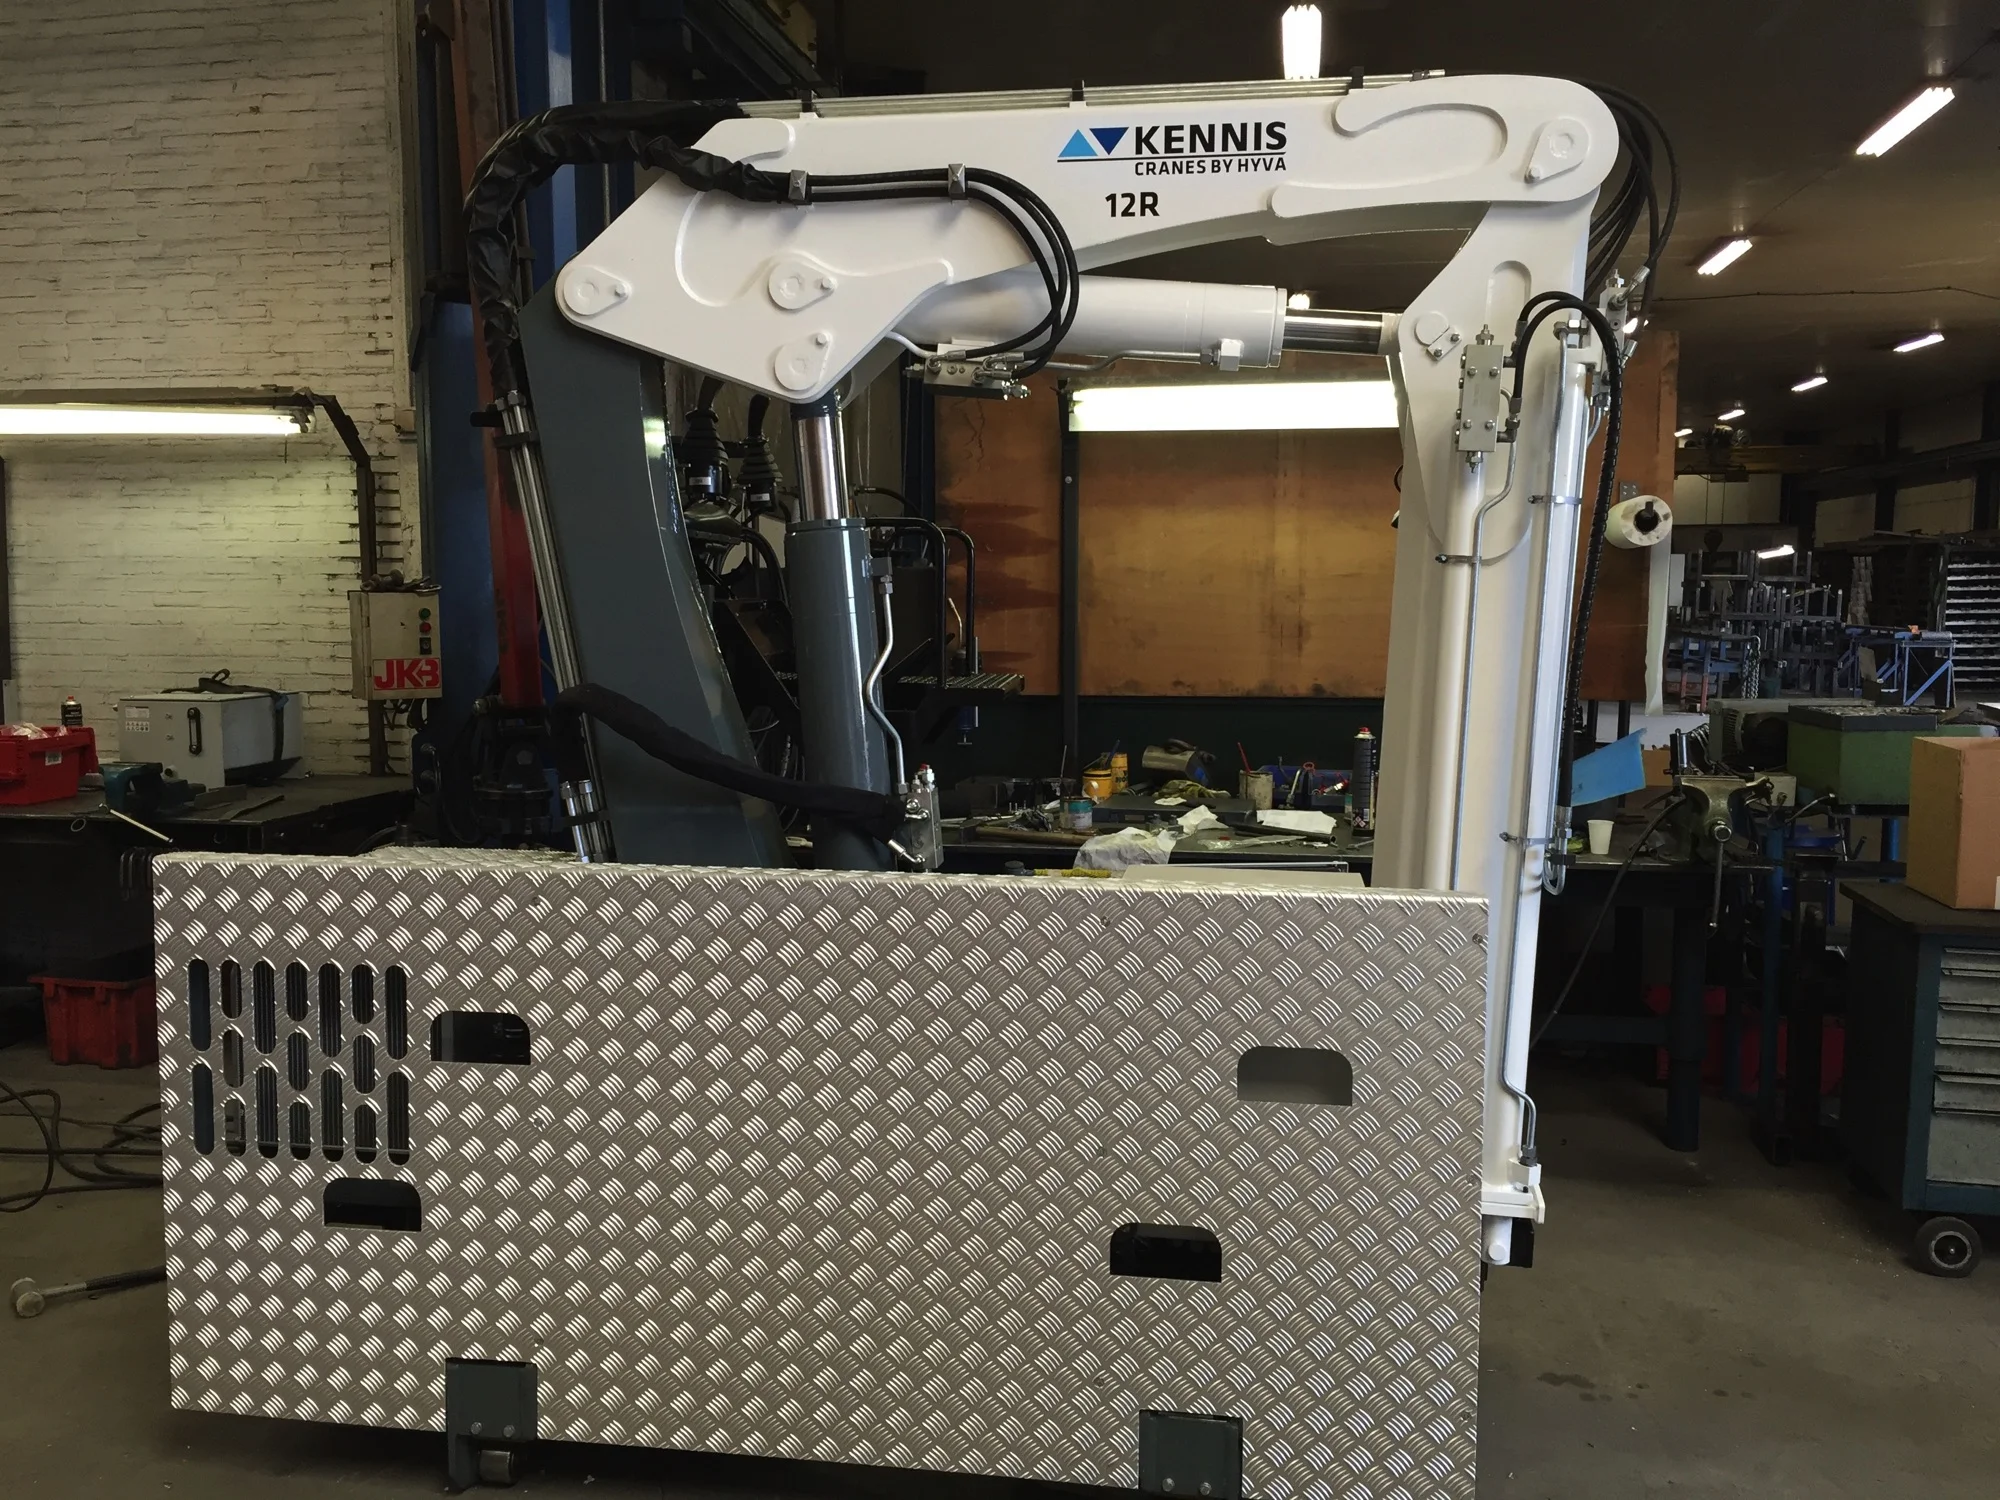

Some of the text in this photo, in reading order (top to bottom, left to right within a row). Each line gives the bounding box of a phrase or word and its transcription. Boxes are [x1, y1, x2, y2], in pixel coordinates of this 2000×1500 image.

[1134, 121, 1288, 155] KENNIS
[1134, 157, 1287, 176] CRANES BY HYVA
[1105, 191, 1160, 218] 12R
